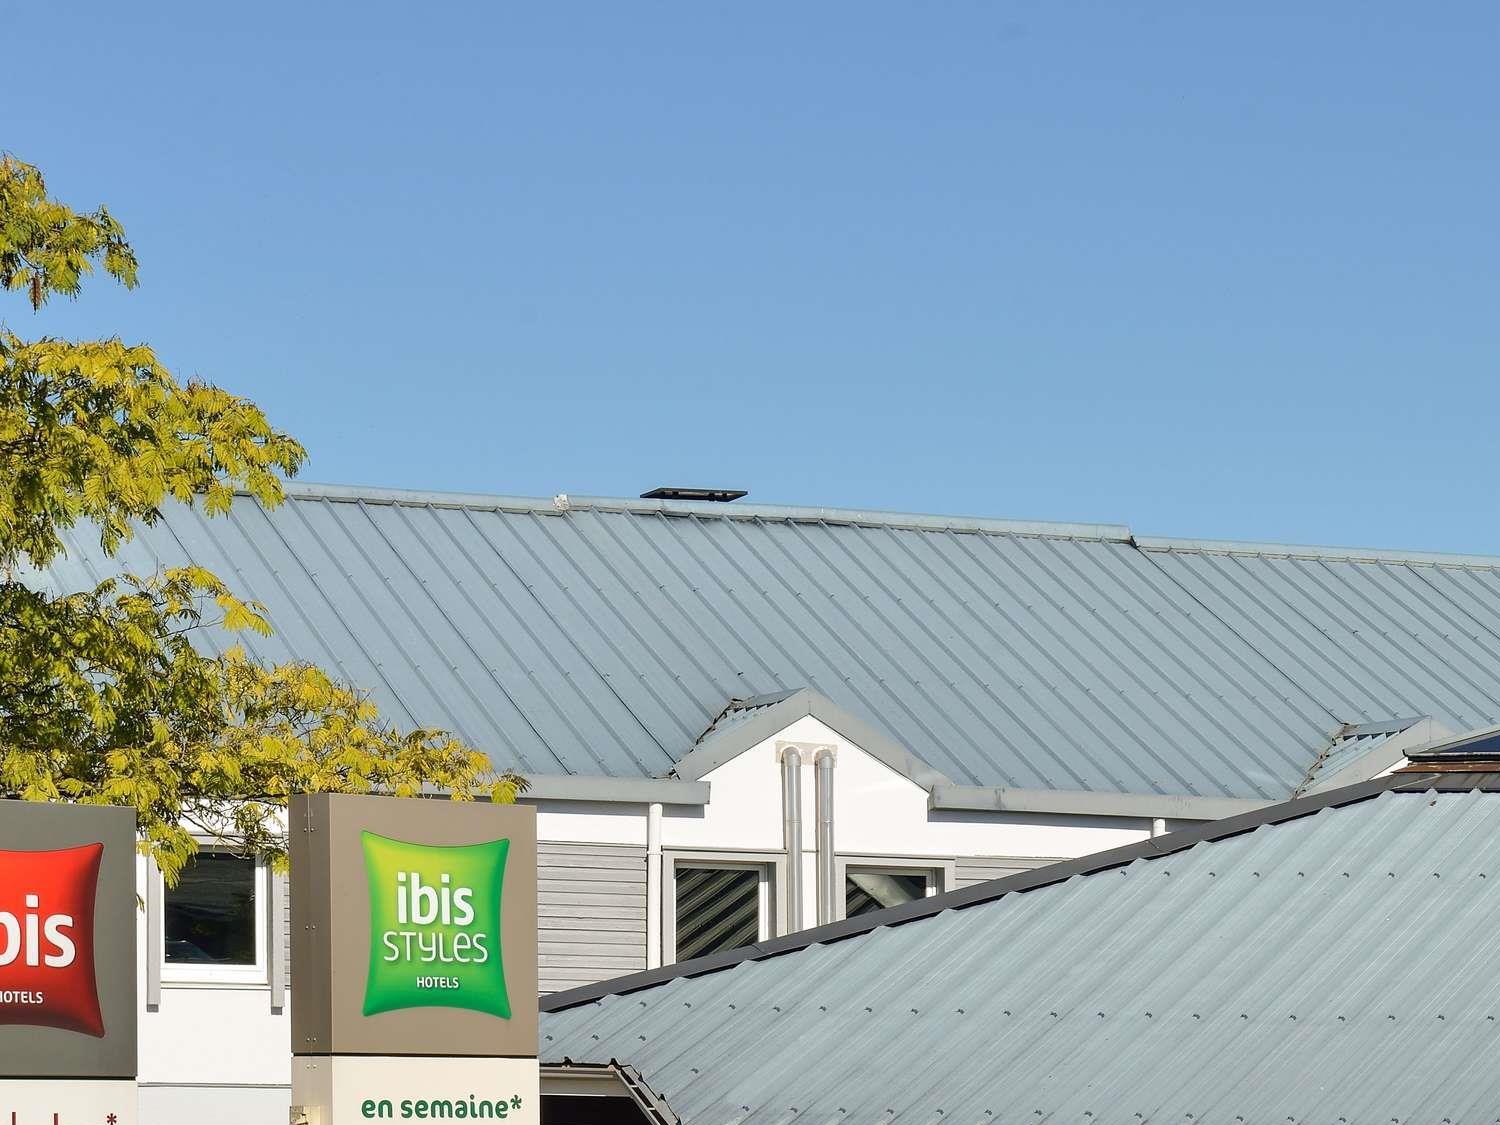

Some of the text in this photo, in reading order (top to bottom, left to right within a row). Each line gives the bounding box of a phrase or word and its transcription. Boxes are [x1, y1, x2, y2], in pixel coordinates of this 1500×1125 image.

[397, 871, 475, 926] ibis
[416, 976, 459, 988] HOTELS
[0, 990, 43, 1004] OTELS
[361, 1099, 393, 1119] en
